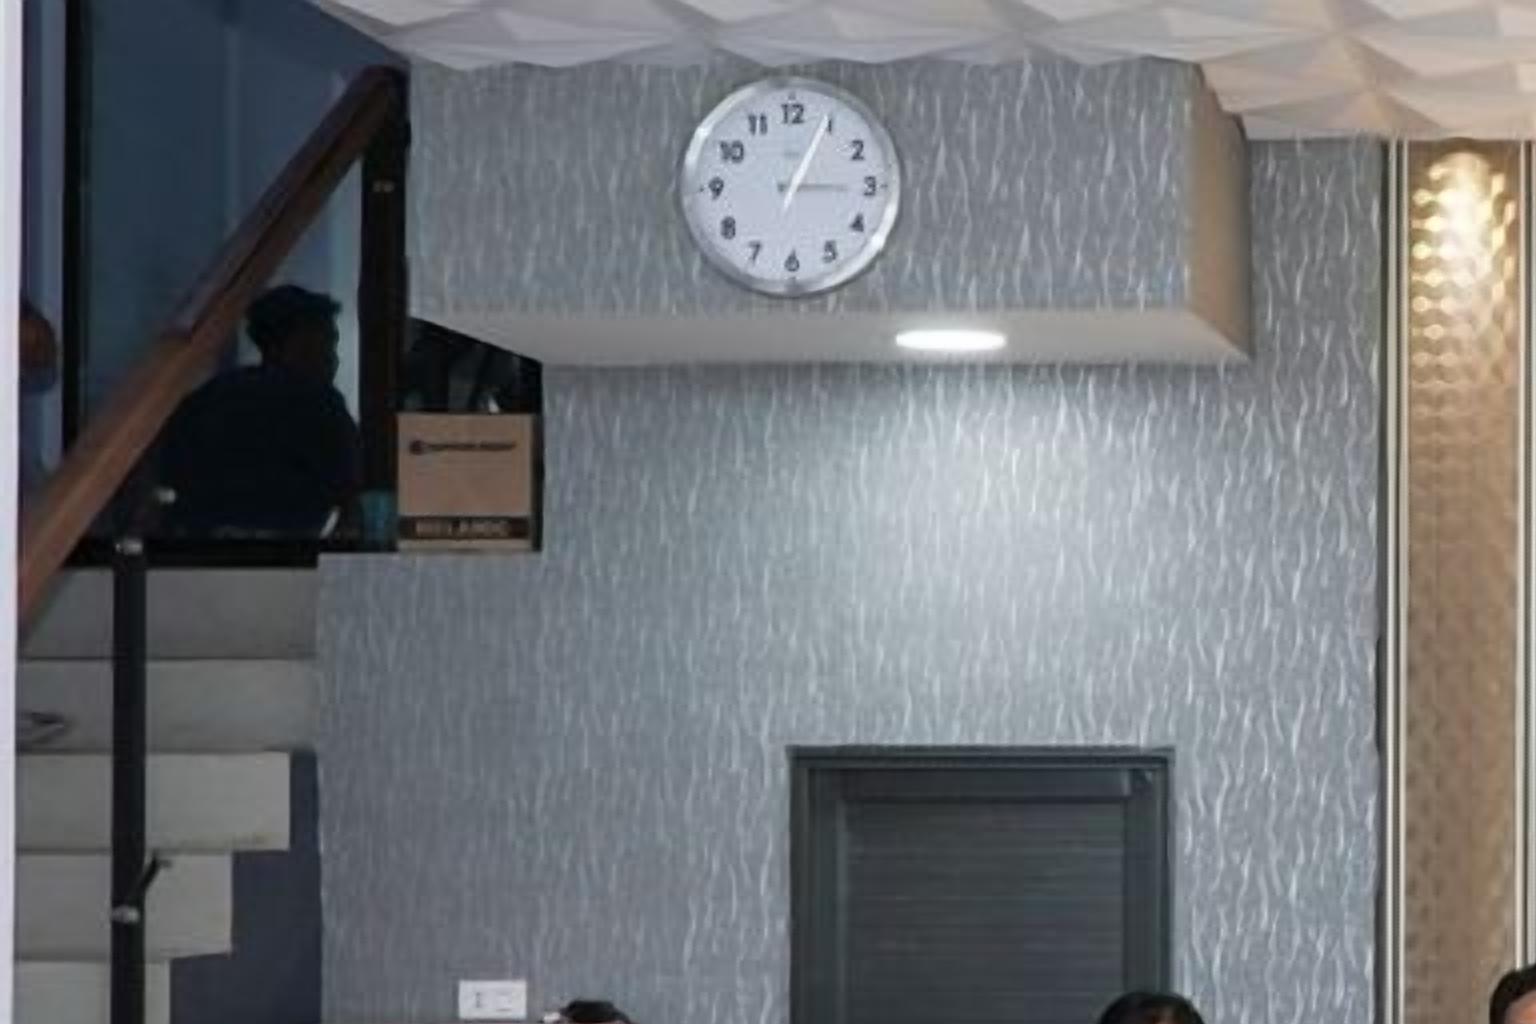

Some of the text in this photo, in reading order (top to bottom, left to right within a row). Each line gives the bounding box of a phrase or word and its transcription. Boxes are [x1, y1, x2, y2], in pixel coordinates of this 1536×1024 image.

[748, 114, 768, 135] 11
[780, 103, 804, 124] 12
[719, 140, 744, 163] 10
[851, 139, 865, 161] 2
[708, 176, 724, 200] 9
[863, 175, 876, 196] 3
[720, 216, 736, 240] 8
[850, 213, 864, 232] 4
[749, 240, 762, 265] 7
[784, 250, 800, 272] 6
[823, 240, 838, 263] 5
